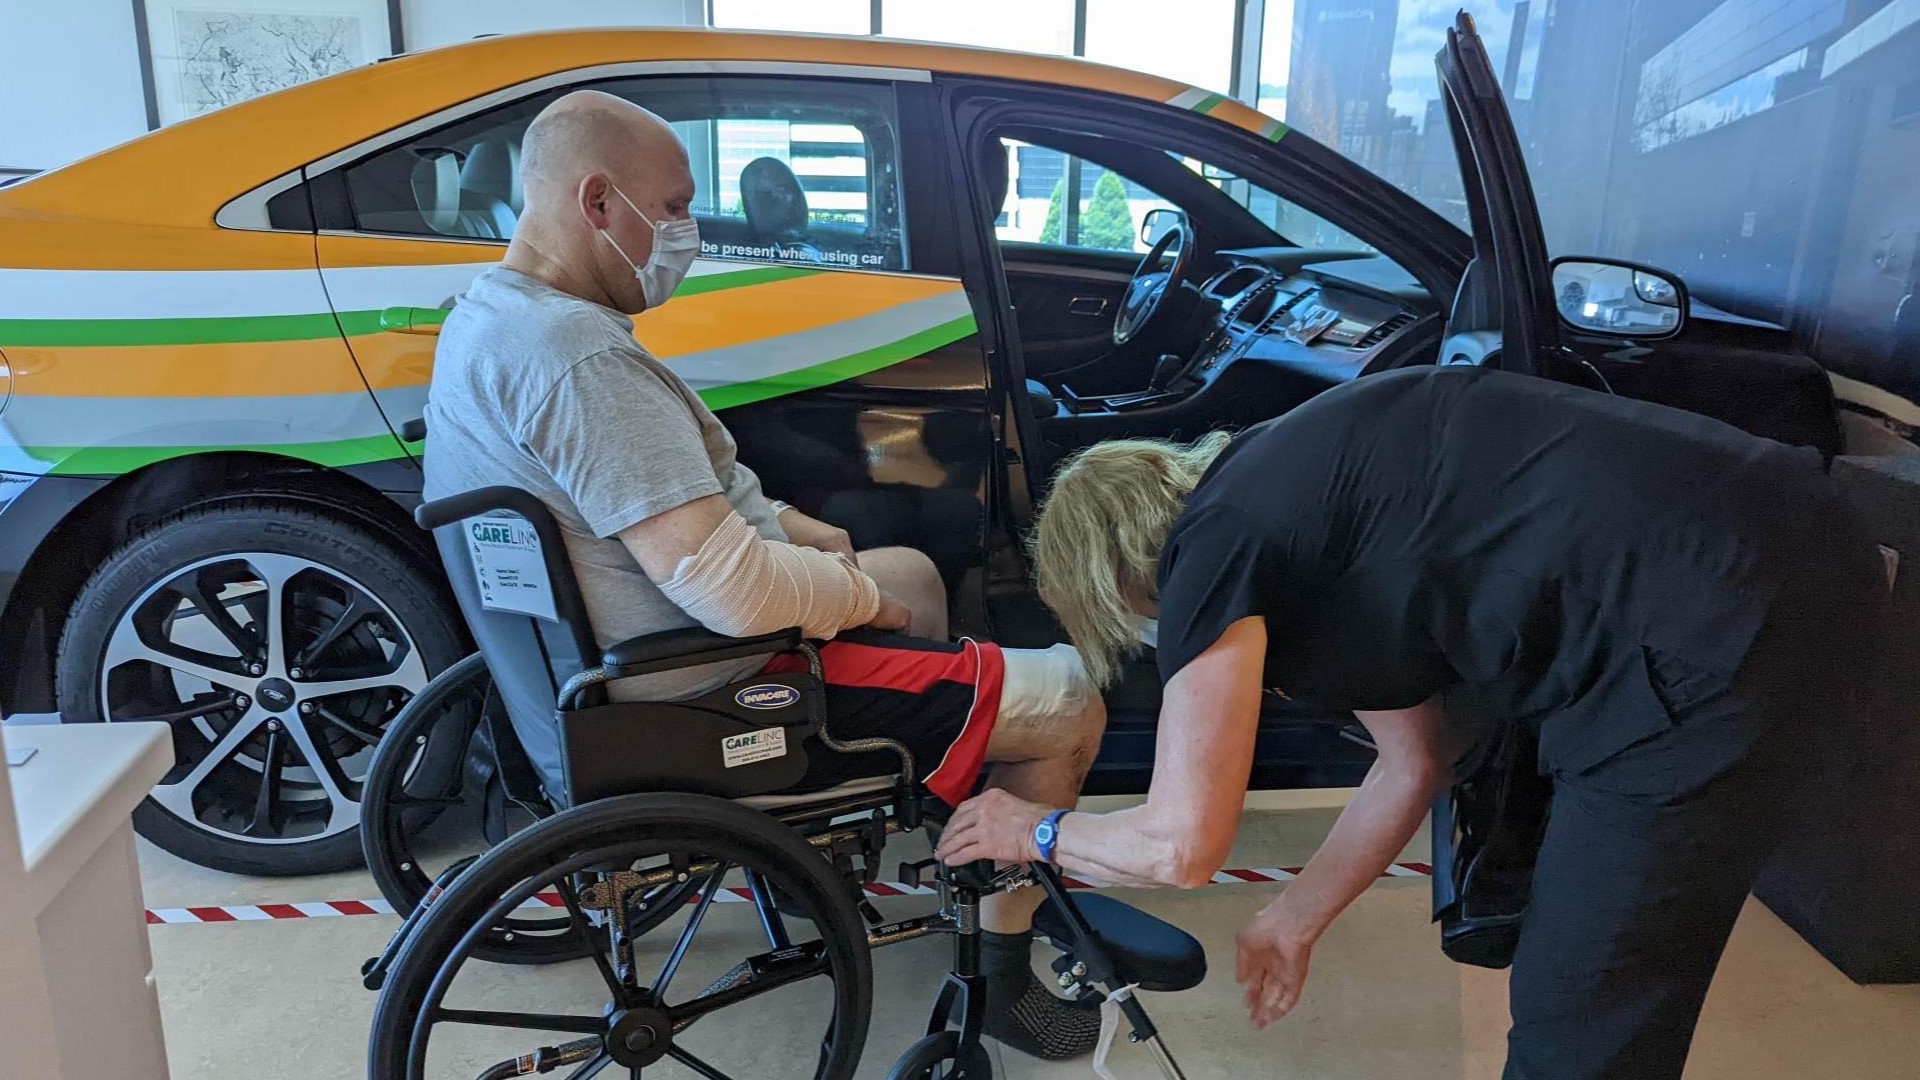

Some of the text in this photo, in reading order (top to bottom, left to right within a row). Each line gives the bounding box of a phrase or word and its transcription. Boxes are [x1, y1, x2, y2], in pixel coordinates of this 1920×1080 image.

[701, 241, 718, 253] be
[722, 243, 775, 258] present
[822, 250, 858, 265] using
[861, 253, 884, 265] car
[472, 522, 537, 549] CARELINC
[744, 690, 790, 703] INVACARE
[726, 729, 783, 750] CARELINC
